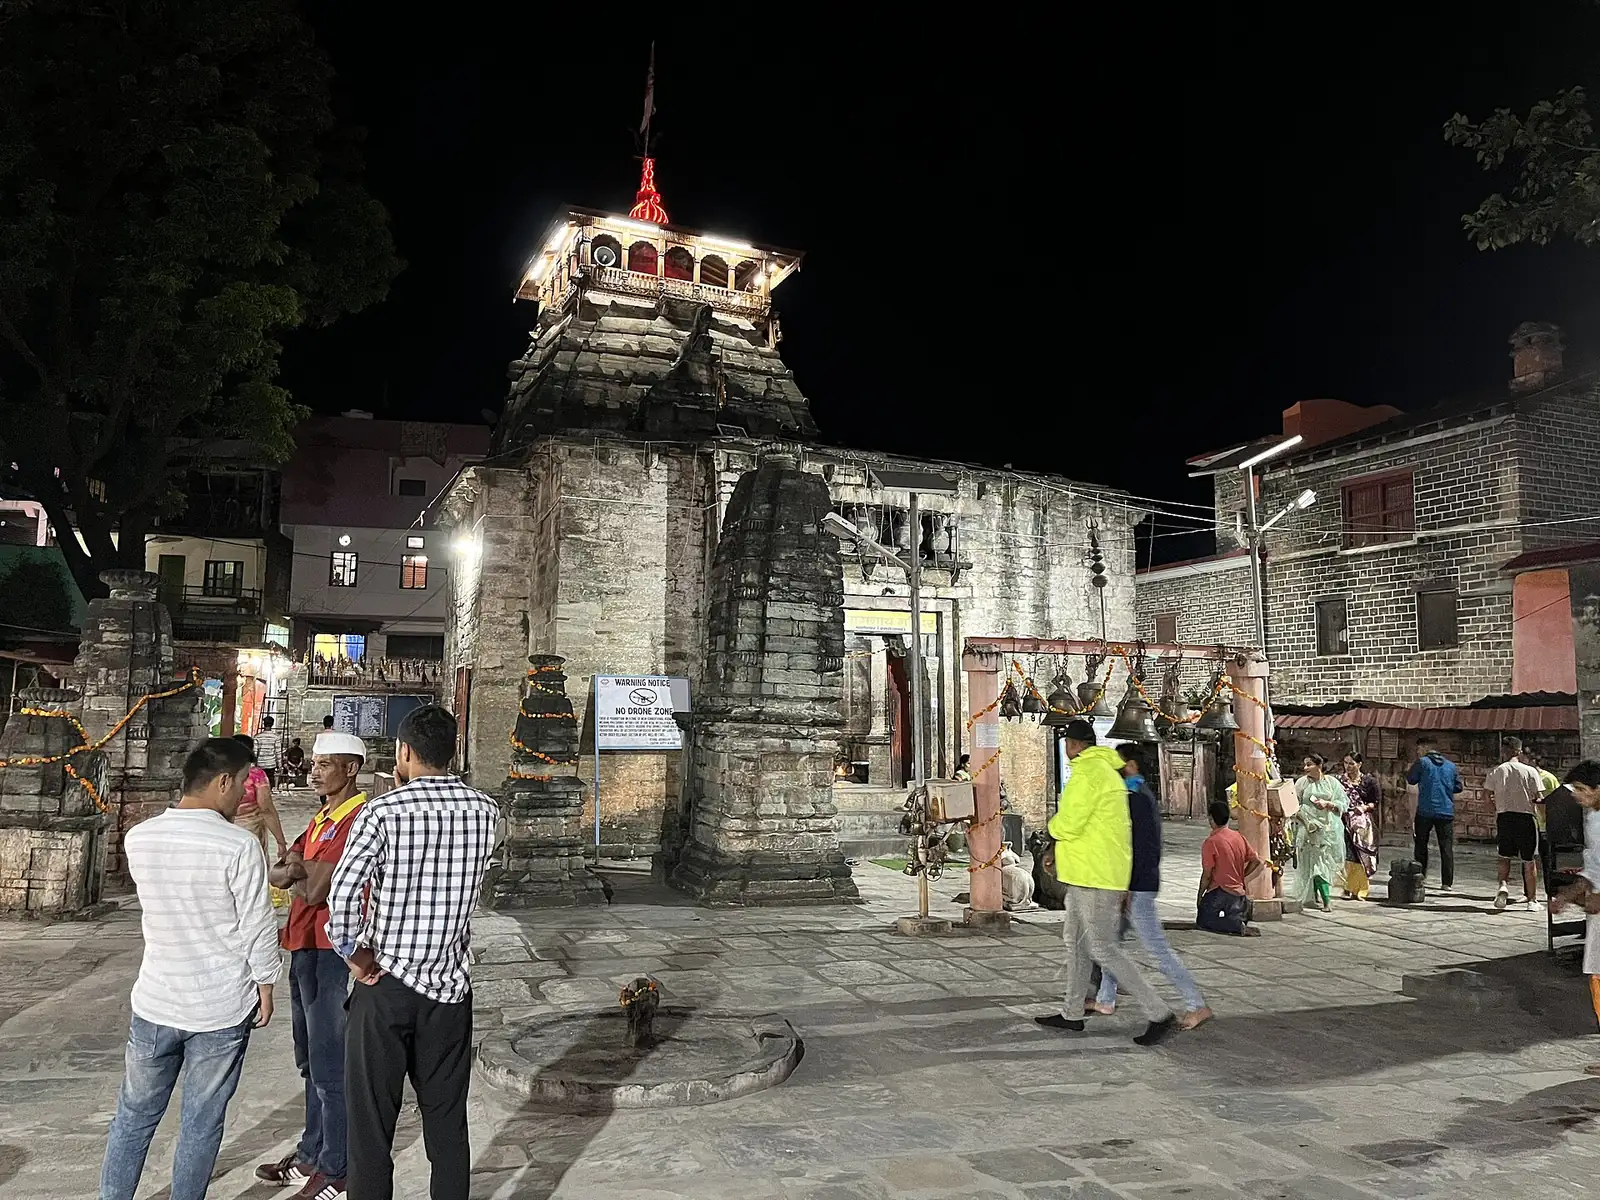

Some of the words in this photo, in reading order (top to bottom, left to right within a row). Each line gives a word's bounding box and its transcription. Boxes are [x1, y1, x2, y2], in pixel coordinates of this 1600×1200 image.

[614, 678, 647, 687] WARNING
[648, 679, 671, 687] NOTICE
[615, 707, 626, 715] NO
[628, 707, 652, 716] DRONE
[654, 707, 674, 716] ZONE
